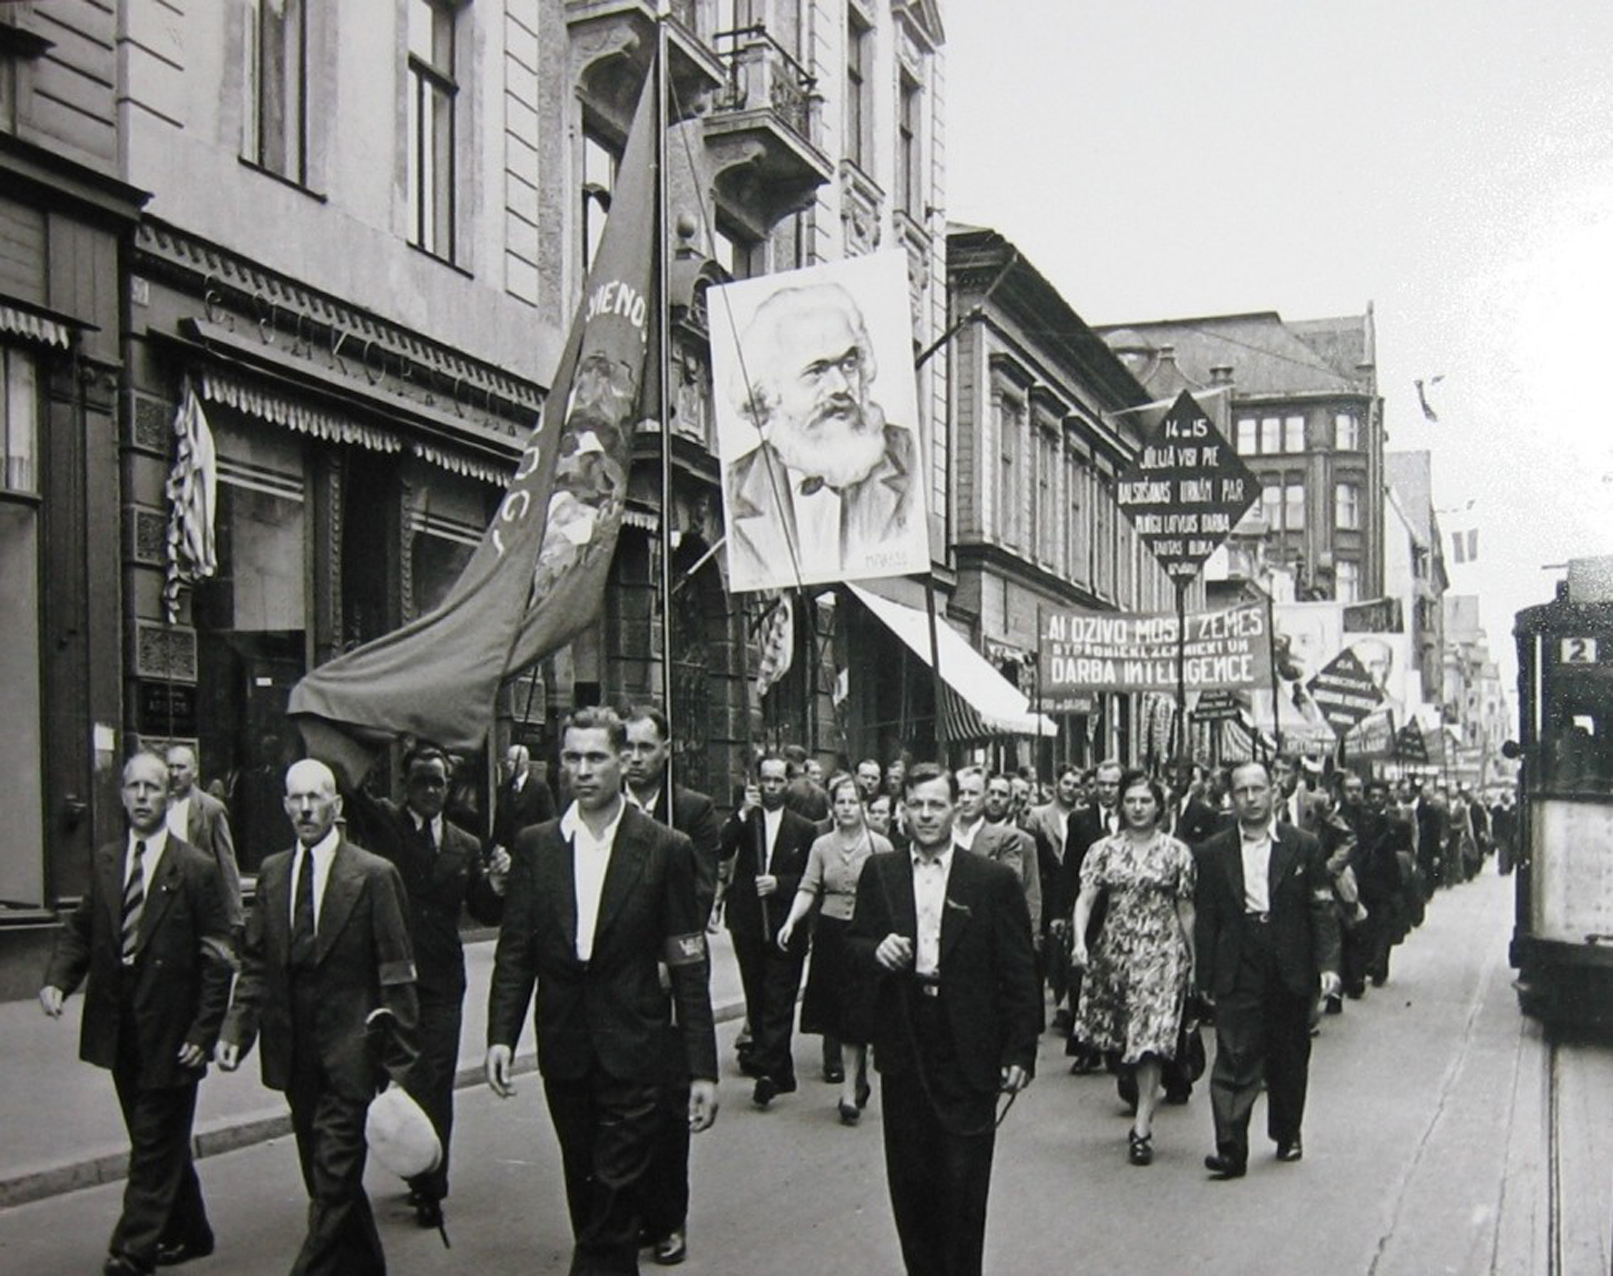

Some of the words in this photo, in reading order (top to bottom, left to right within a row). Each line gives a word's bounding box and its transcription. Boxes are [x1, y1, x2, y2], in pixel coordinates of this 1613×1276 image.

[1222, 478, 1244, 502] PAR
[1198, 608, 1263, 639] ZEMES
[1227, 638, 1249, 653] UN
[1569, 639, 1587, 662] 2
[1051, 656, 1117, 685] DARBA
